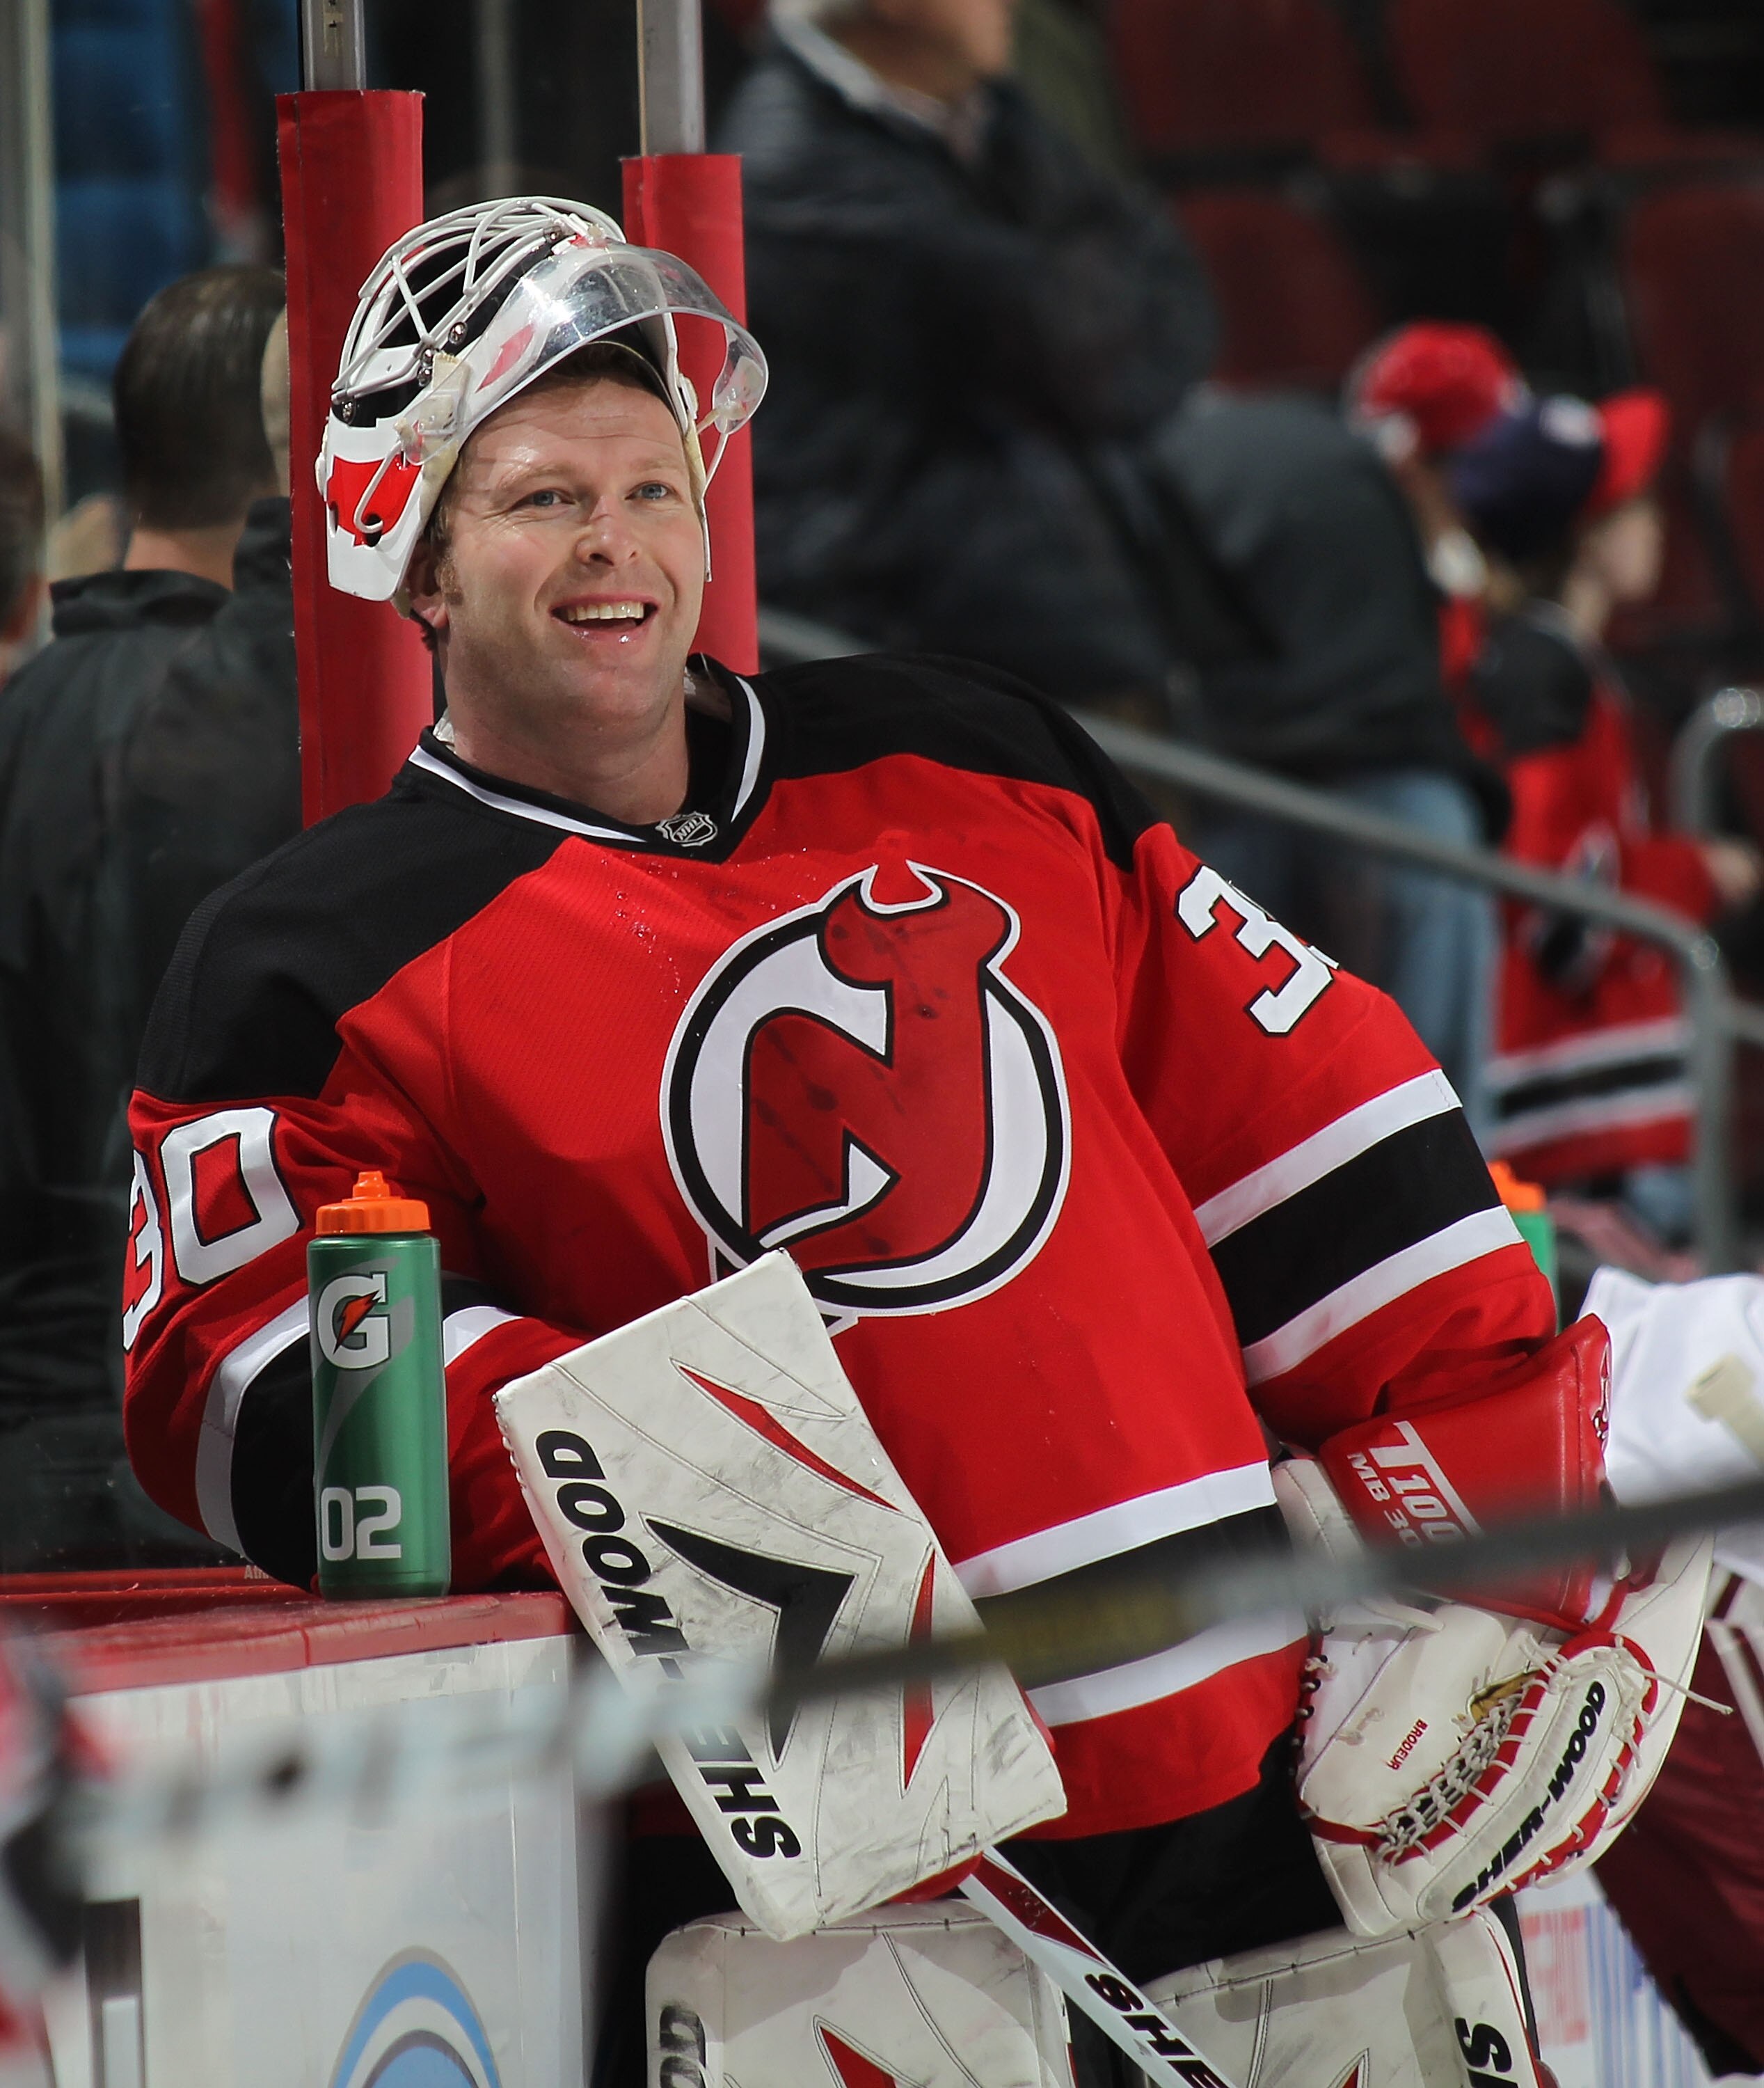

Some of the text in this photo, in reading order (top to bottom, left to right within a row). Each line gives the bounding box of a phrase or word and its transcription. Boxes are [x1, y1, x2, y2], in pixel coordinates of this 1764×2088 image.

[676, 816, 703, 841] NHL
[1177, 864, 1340, 1034] 3
[122, 1107, 300, 1351] 30
[317, 1273, 390, 1369] G
[1347, 1451, 1390, 1501] MB
[535, 1429, 802, 1860] SHE-WOOD
[1385, 1718, 1429, 1770] BRODEUR
